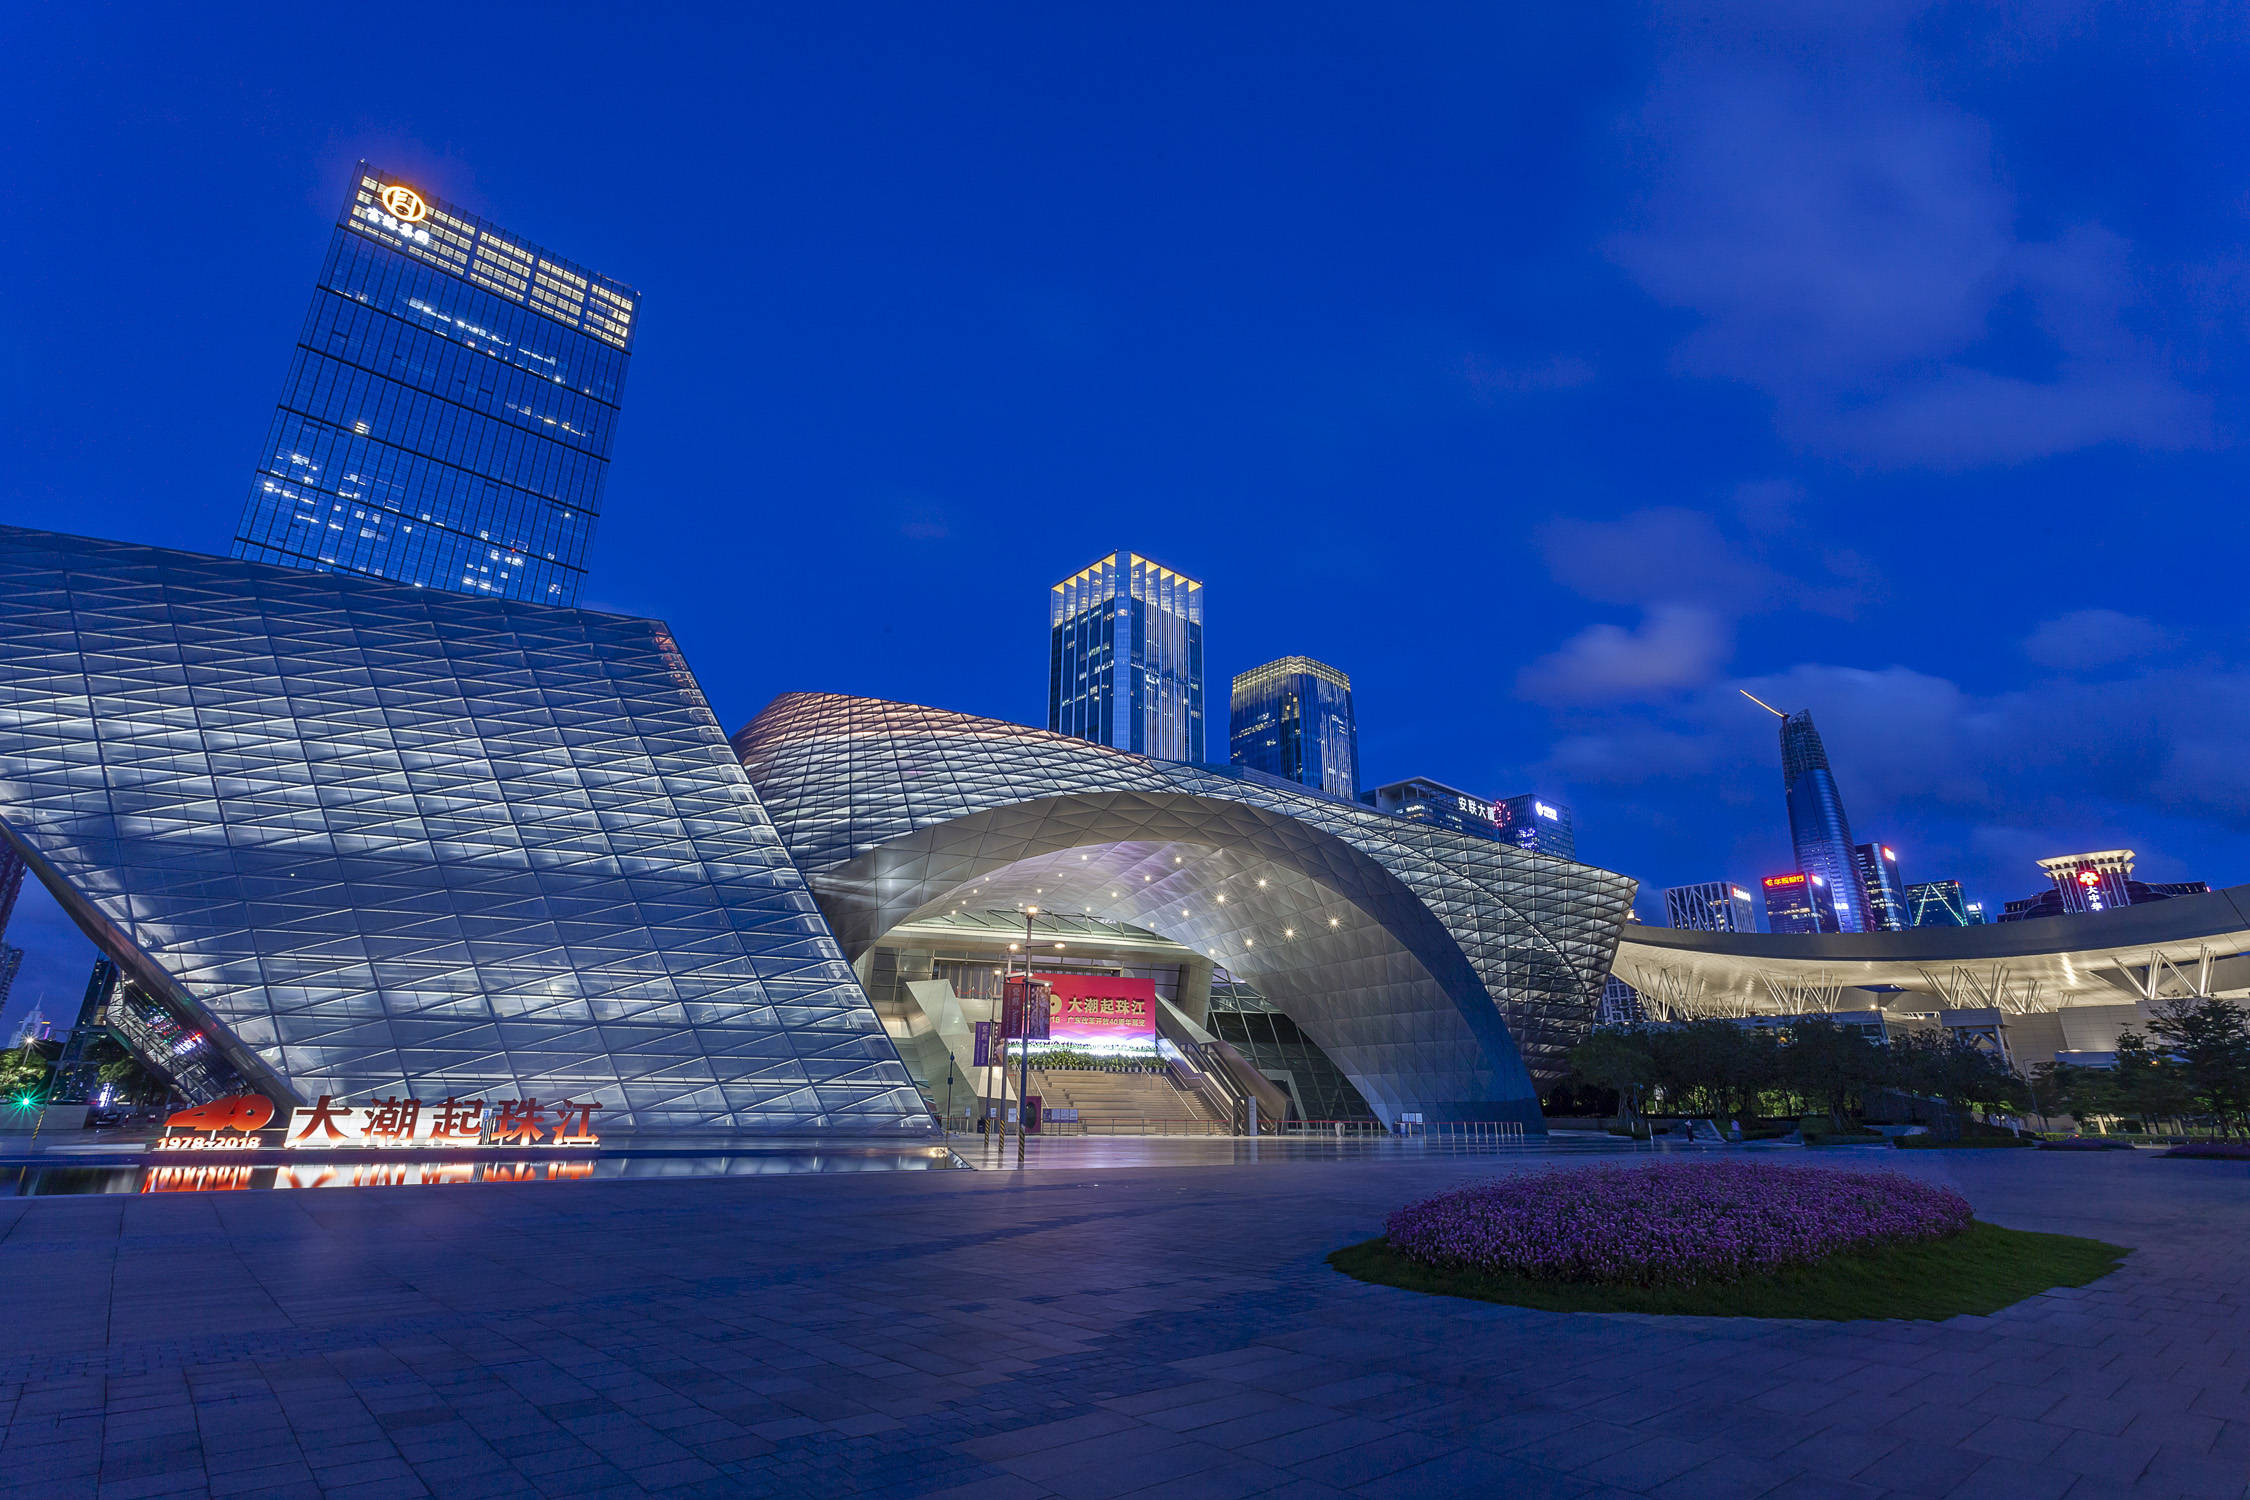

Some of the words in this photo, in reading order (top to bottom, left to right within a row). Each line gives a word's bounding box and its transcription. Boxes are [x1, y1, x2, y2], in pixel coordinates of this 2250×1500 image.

[2086, 886, 2103, 911] 大中华
[1067, 996, 1146, 1015] 大潮起珠江
[284, 1094, 603, 1148] 大潮起珠江
